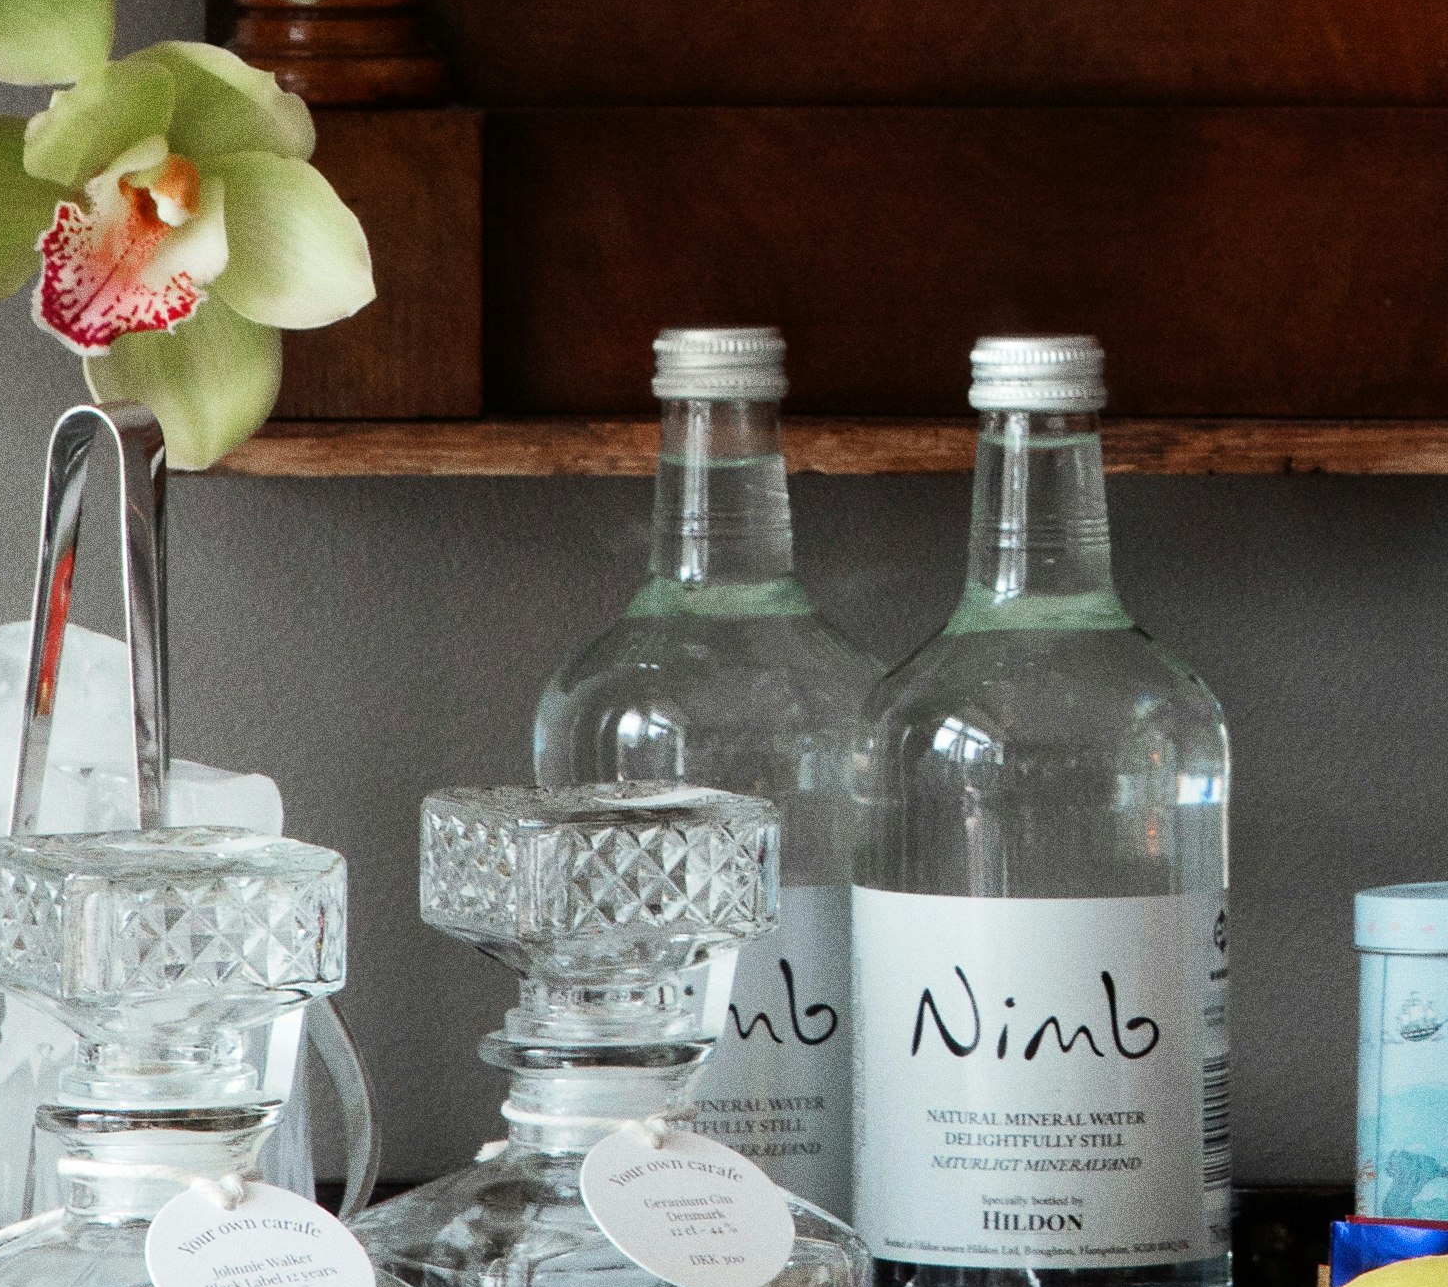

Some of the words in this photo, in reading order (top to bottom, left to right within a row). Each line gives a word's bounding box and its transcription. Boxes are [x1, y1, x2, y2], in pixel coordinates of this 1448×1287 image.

[911, 965, 1159, 1060] Nimb
[693, 1098, 766, 1112] INERAL
[768, 1096, 825, 1111] WATER
[691, 1119, 754, 1134] TFULLY
[759, 1119, 807, 1133] STILL
[926, 1110, 998, 1127] NATURAL
[1005, 1112, 1085, 1127] MINERAL
[1089, 1111, 1146, 1126] WATER
[944, 1132, 1076, 1148] DELIGHTFULLY
[1080, 1133, 1125, 1147] STILL
[932, 1155, 1023, 1172] NATURLIGT
[1025, 1157, 1142, 1172] MINERALVAND
[608, 1164, 645, 1187] Your
[646, 1159, 683, 1173] own
[687, 1160, 743, 1183] carafe
[644, 1196, 708, 1210] Geranium
[710, 1193, 733, 1205] Gin
[982, 1195, 1027, 1208] Specially
[1031, 1195, 1068, 1207] bottled
[1071, 1195, 1083, 1208] by
[666, 1208, 726, 1222] Denmark
[982, 1211, 1083, 1231] HILDON
[177, 1228, 216, 1256] Your
[218, 1218, 257, 1236] own
[262, 1217, 323, 1239] carafe
[671, 1227, 683, 1237] 12
[685, 1224, 697, 1236] cl
[212, 1261, 265, 1281] Johnnie
[266, 1252, 313, 1270] Walker
[689, 1254, 717, 1265] DKK
[720, 1254, 745, 1264] 300
[287, 1272, 299, 1284] 12
[299, 1266, 339, 1283] years
